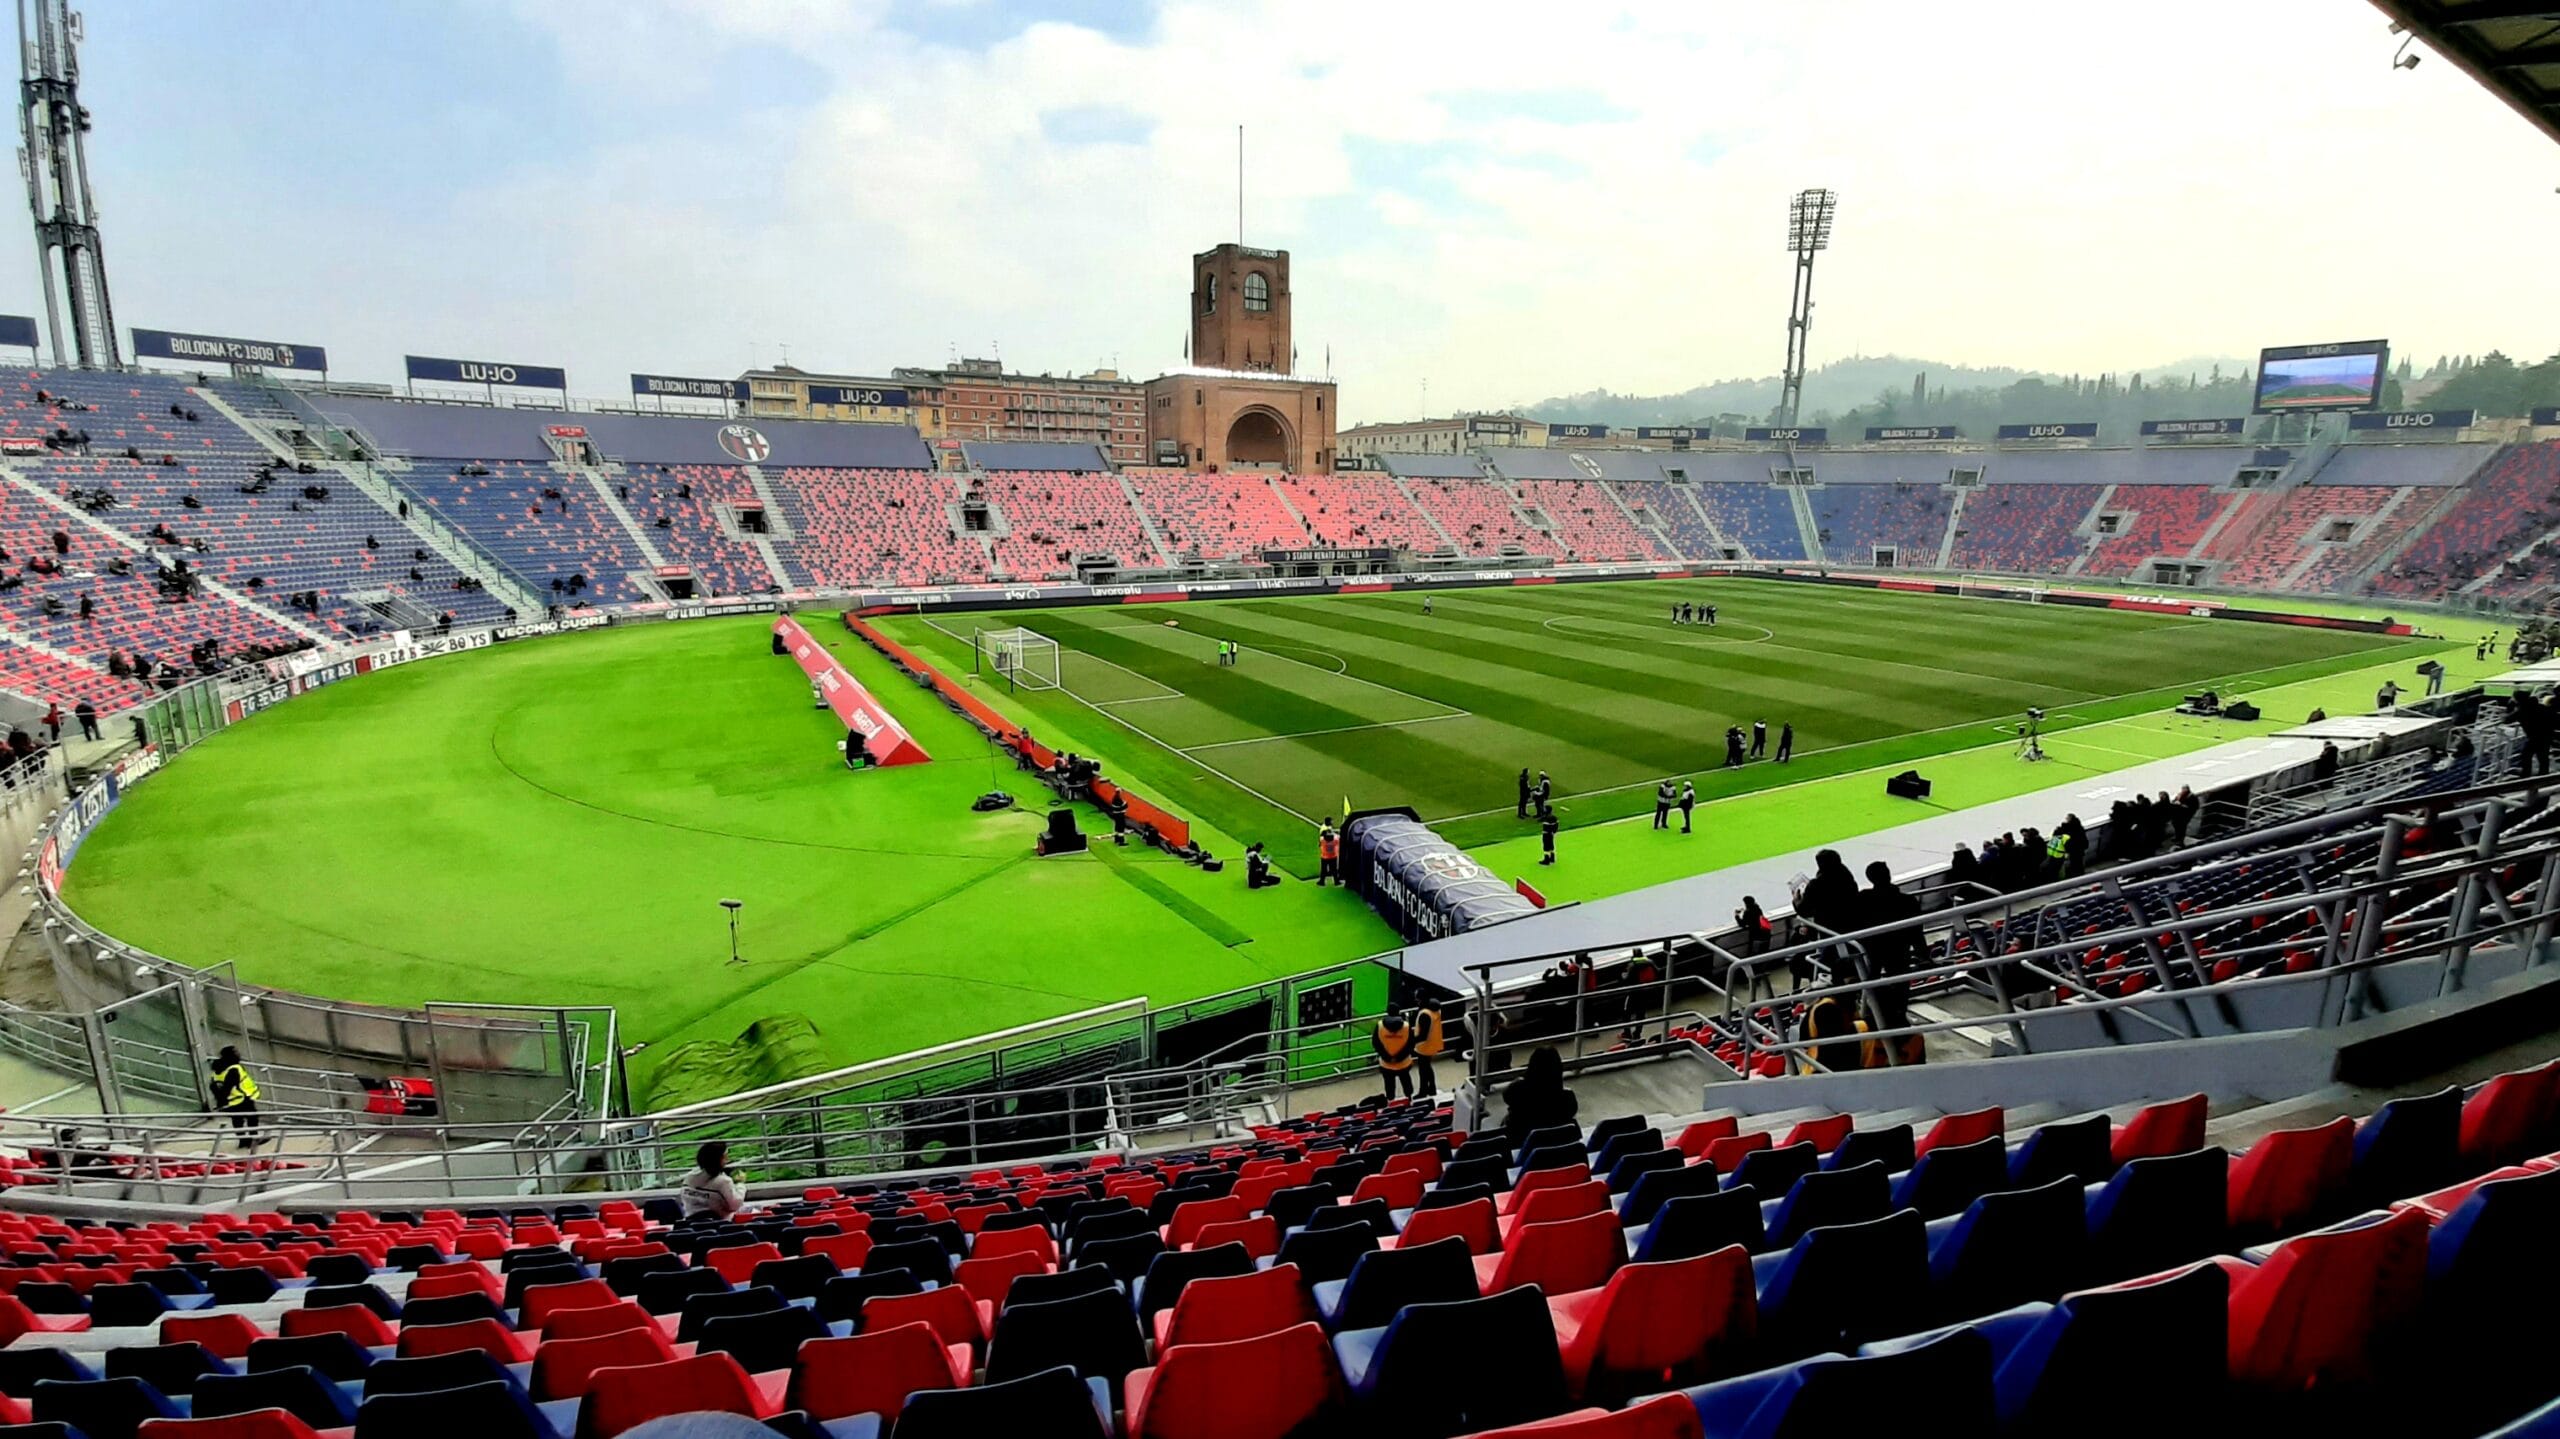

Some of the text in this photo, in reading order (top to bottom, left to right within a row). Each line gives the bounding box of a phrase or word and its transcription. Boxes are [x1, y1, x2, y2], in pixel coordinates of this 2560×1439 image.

[171, 338, 274, 361] BOLOGNA FC 1909
[648, 379, 721, 395] BOLOGNA FC 1909
[496, 615, 609, 639] VECCHIO CUORE
[448, 633, 487, 651] BOYS
[304, 662, 353, 690] ULTRAS
[1373, 860, 1405, 909] BOLOGNA
[1406, 888, 1418, 918] FC
